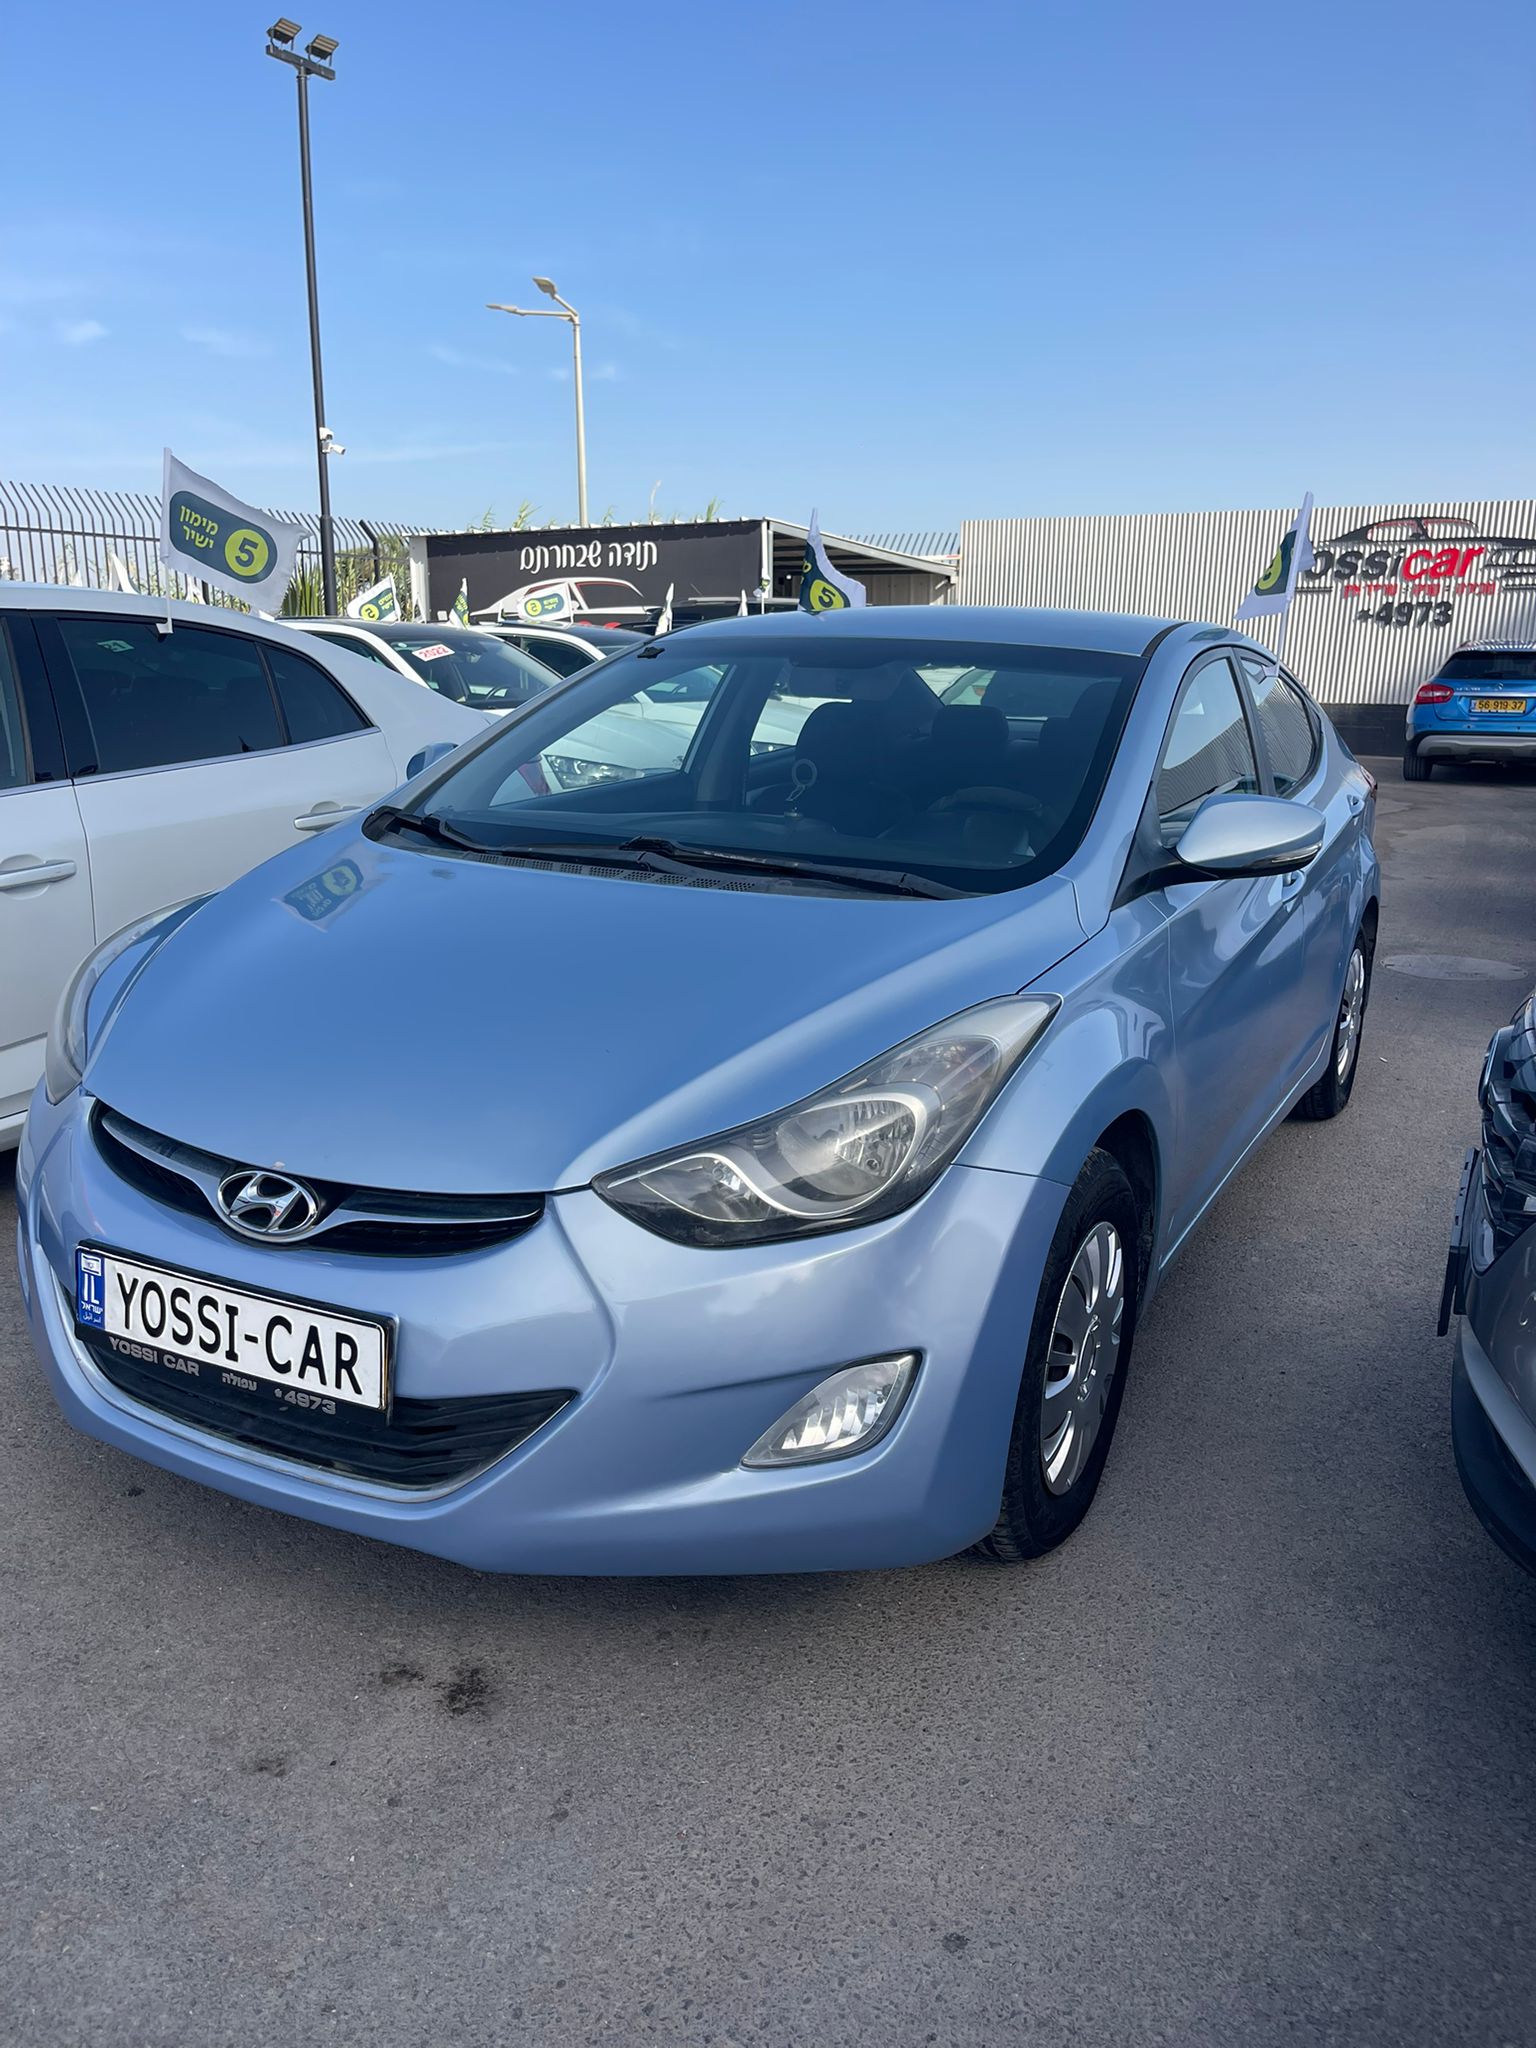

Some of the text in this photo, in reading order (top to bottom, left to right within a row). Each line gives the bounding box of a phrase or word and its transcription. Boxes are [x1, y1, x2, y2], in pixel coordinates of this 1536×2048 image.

[180, 505, 219, 536] מימון
[183, 525, 214, 549] ישיר
[235, 537, 259, 568] 5
[520, 540, 658, 574] תודה שבחרתם
[1304, 546, 1485, 581] ossicar
[818, 587, 835, 608] 5
[83, 1273, 100, 1305] IL
[81, 1300, 104, 1315] ישראל
[116, 1272, 363, 1395] YOSSI-CAR
[109, 1336, 159, 1364] YOSSI
[163, 1355, 200, 1377] CAR
[221, 1372, 258, 1392] עפולה
